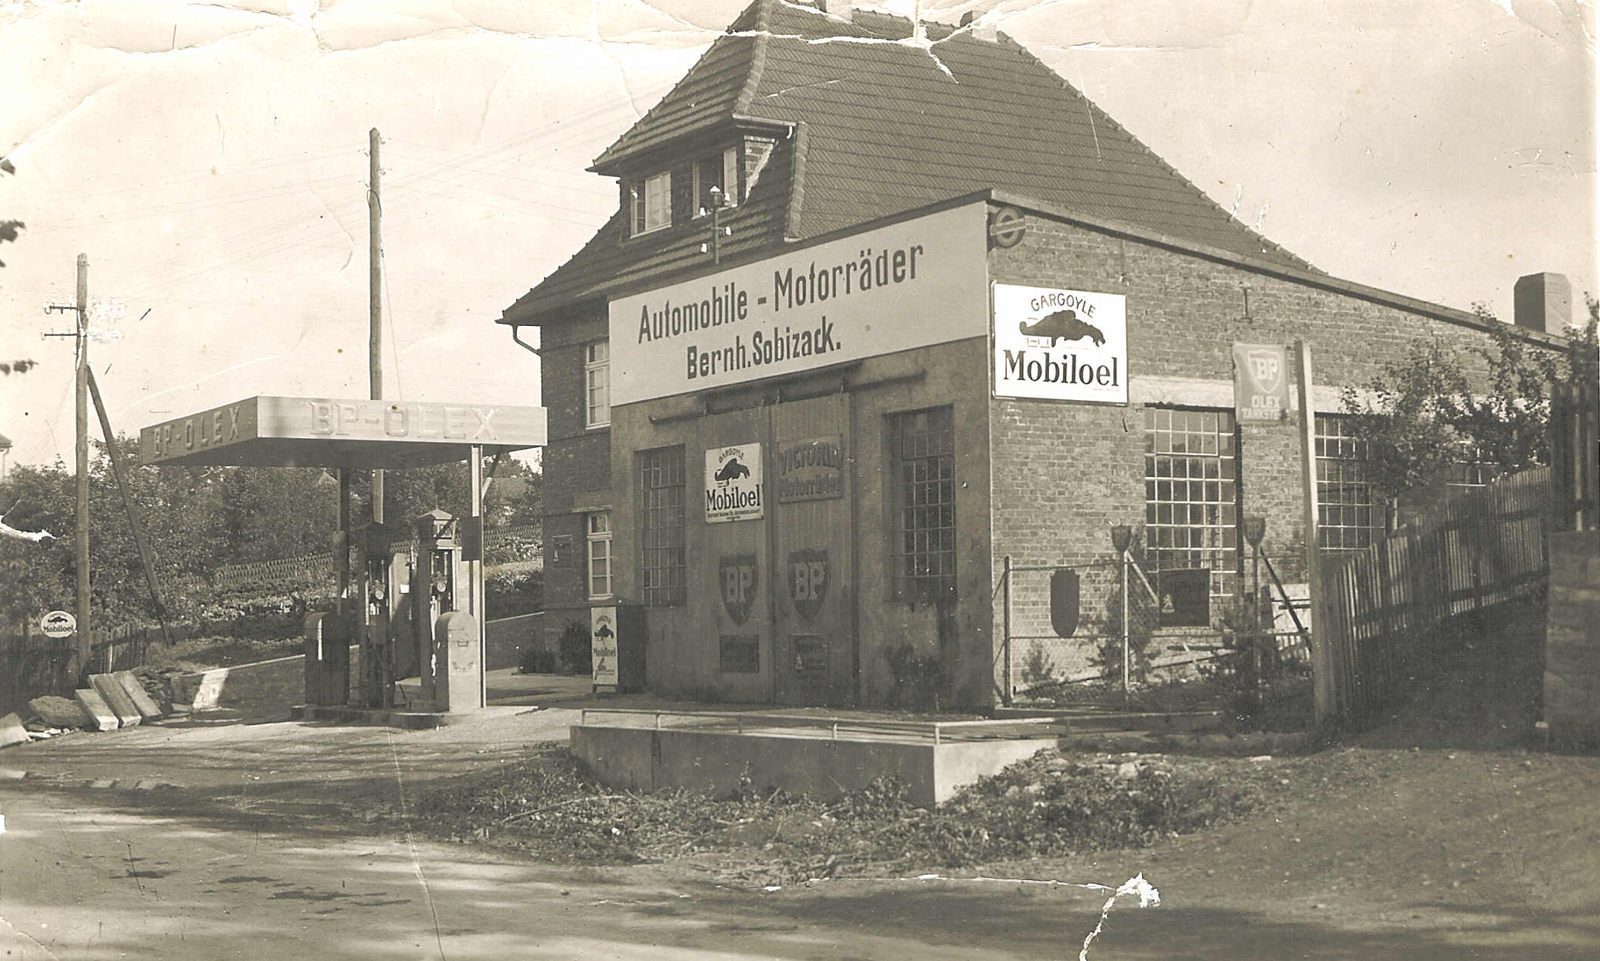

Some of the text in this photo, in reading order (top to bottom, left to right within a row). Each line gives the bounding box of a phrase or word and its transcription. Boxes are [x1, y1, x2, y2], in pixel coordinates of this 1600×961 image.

[638, 281, 748, 344] Automobile
[774, 244, 924, 312] Motorräder
[1030, 293, 1096, 318] GARGOYLE
[1003, 349, 1119, 387] Mobiloel
[1256, 360, 1278, 380] BP
[1251, 395, 1280, 410] OLEX
[706, 484, 761, 512] Mobiloel
[725, 564, 753, 602] BP
[794, 561, 825, 600] BP
